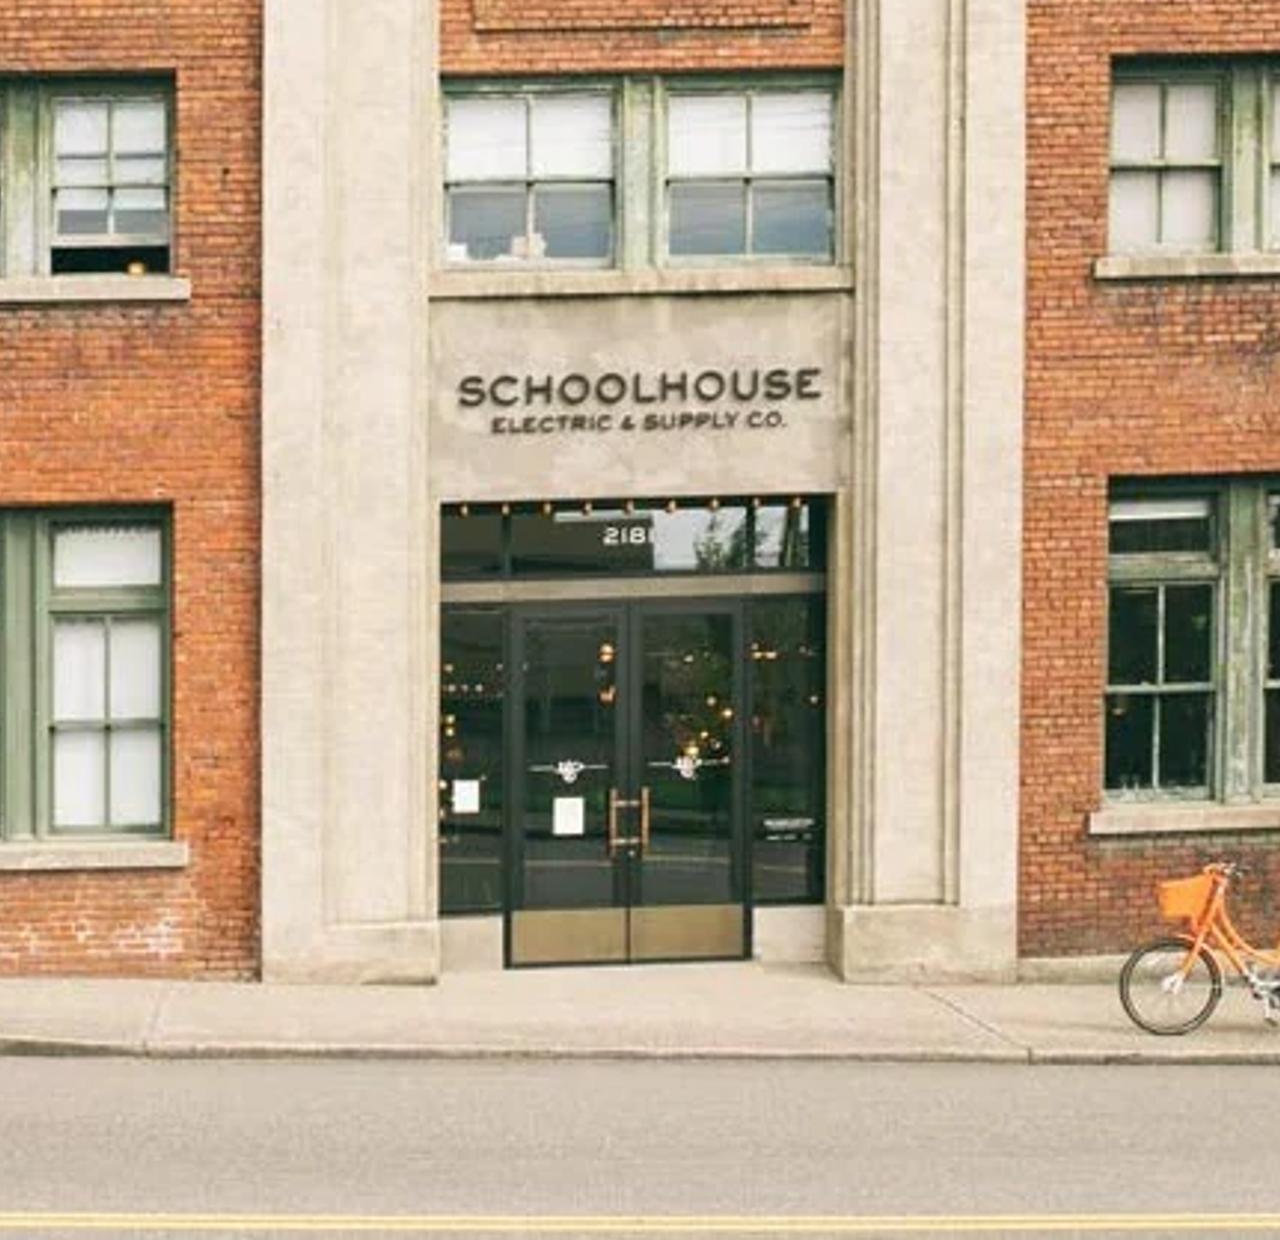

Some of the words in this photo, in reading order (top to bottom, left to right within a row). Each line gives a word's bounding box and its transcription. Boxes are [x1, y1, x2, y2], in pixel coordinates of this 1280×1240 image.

[458, 369, 822, 407] SCHOOLHOUSE
[491, 414, 612, 434] ELECTRIC
[620, 415, 635, 431] &
[643, 412, 739, 431] SUPPLY
[747, 410, 786, 429] CO.
